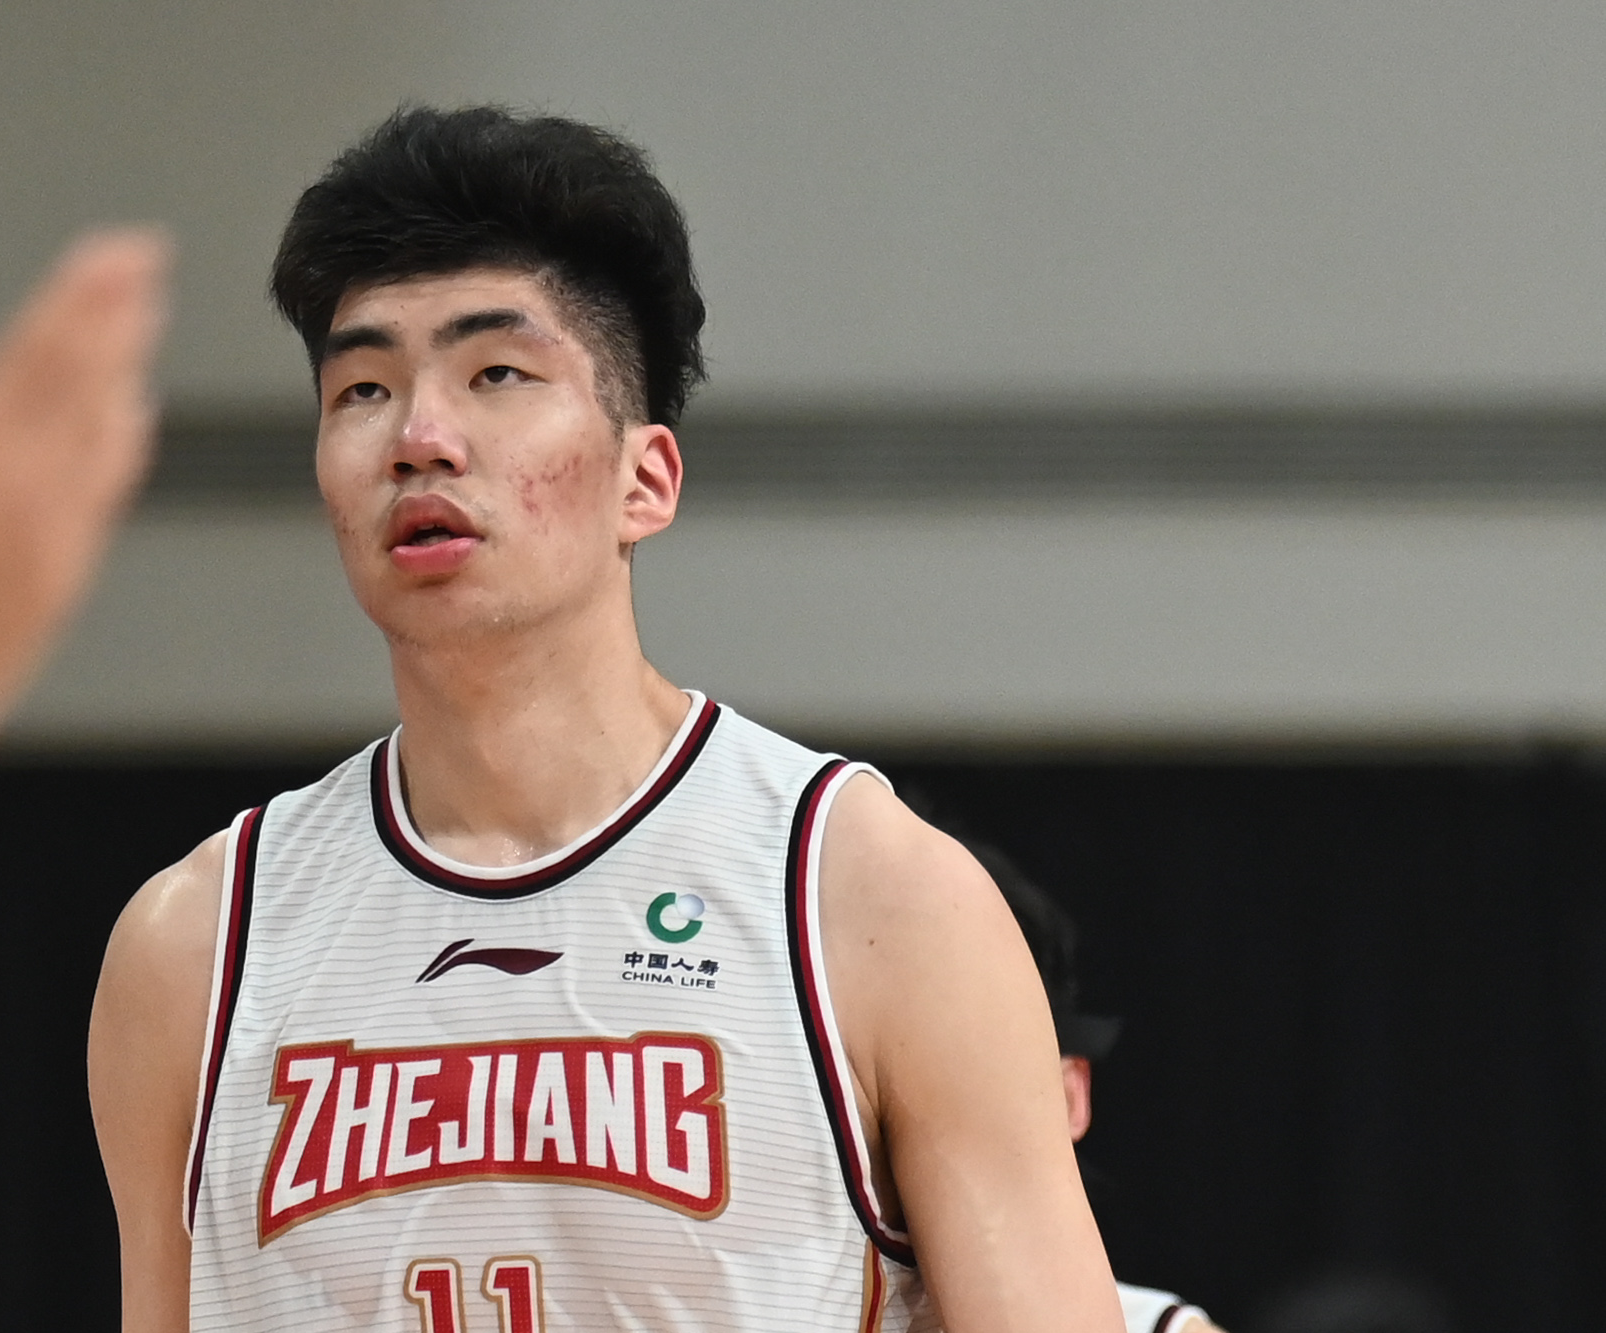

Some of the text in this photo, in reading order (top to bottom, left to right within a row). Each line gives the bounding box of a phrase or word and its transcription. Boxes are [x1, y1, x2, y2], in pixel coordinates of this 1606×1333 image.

[623, 951, 720, 976] 中国人寿
[622, 971, 716, 989] CHINA LIFE
[267, 1043, 712, 1219] ZHEJIANG
